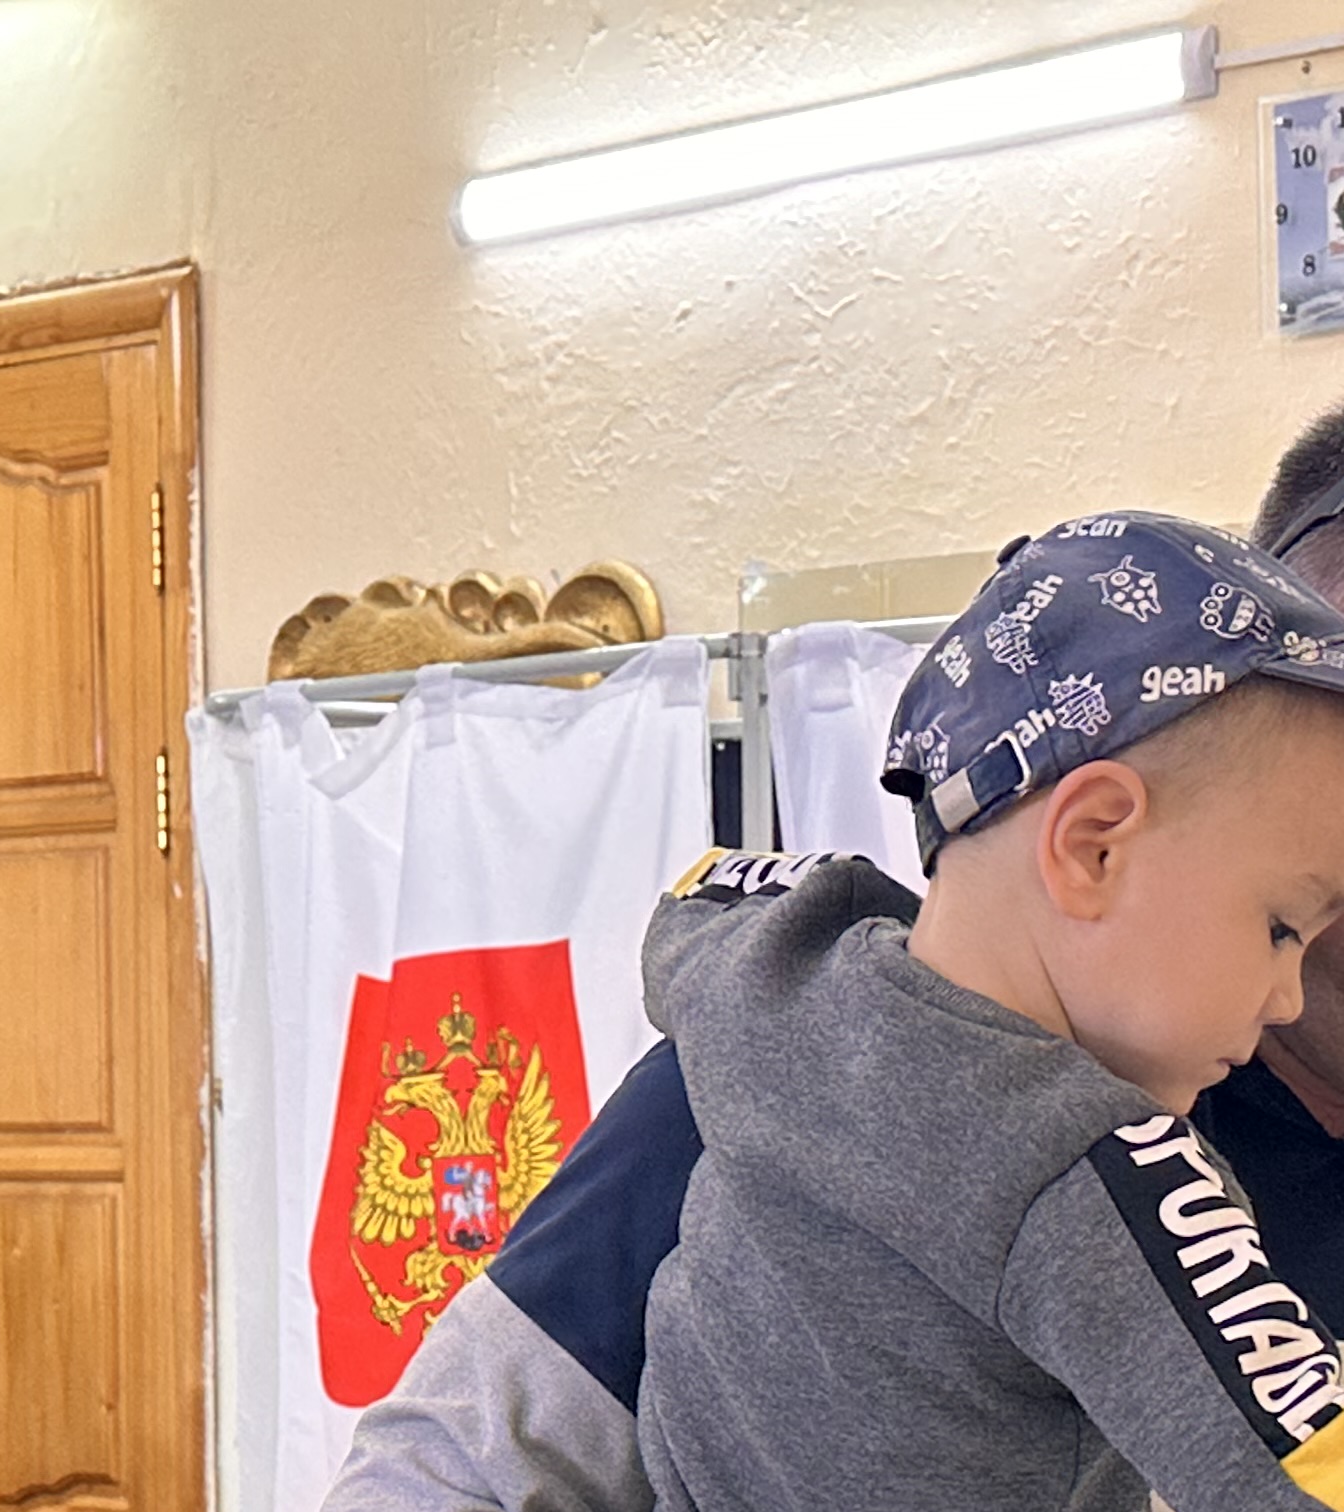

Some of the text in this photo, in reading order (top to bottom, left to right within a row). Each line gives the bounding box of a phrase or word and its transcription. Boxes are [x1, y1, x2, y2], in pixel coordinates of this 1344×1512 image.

[1292, 145, 1316, 168] 10
[1275, 204, 1289, 225] 9
[1303, 255, 1316, 276] 8
